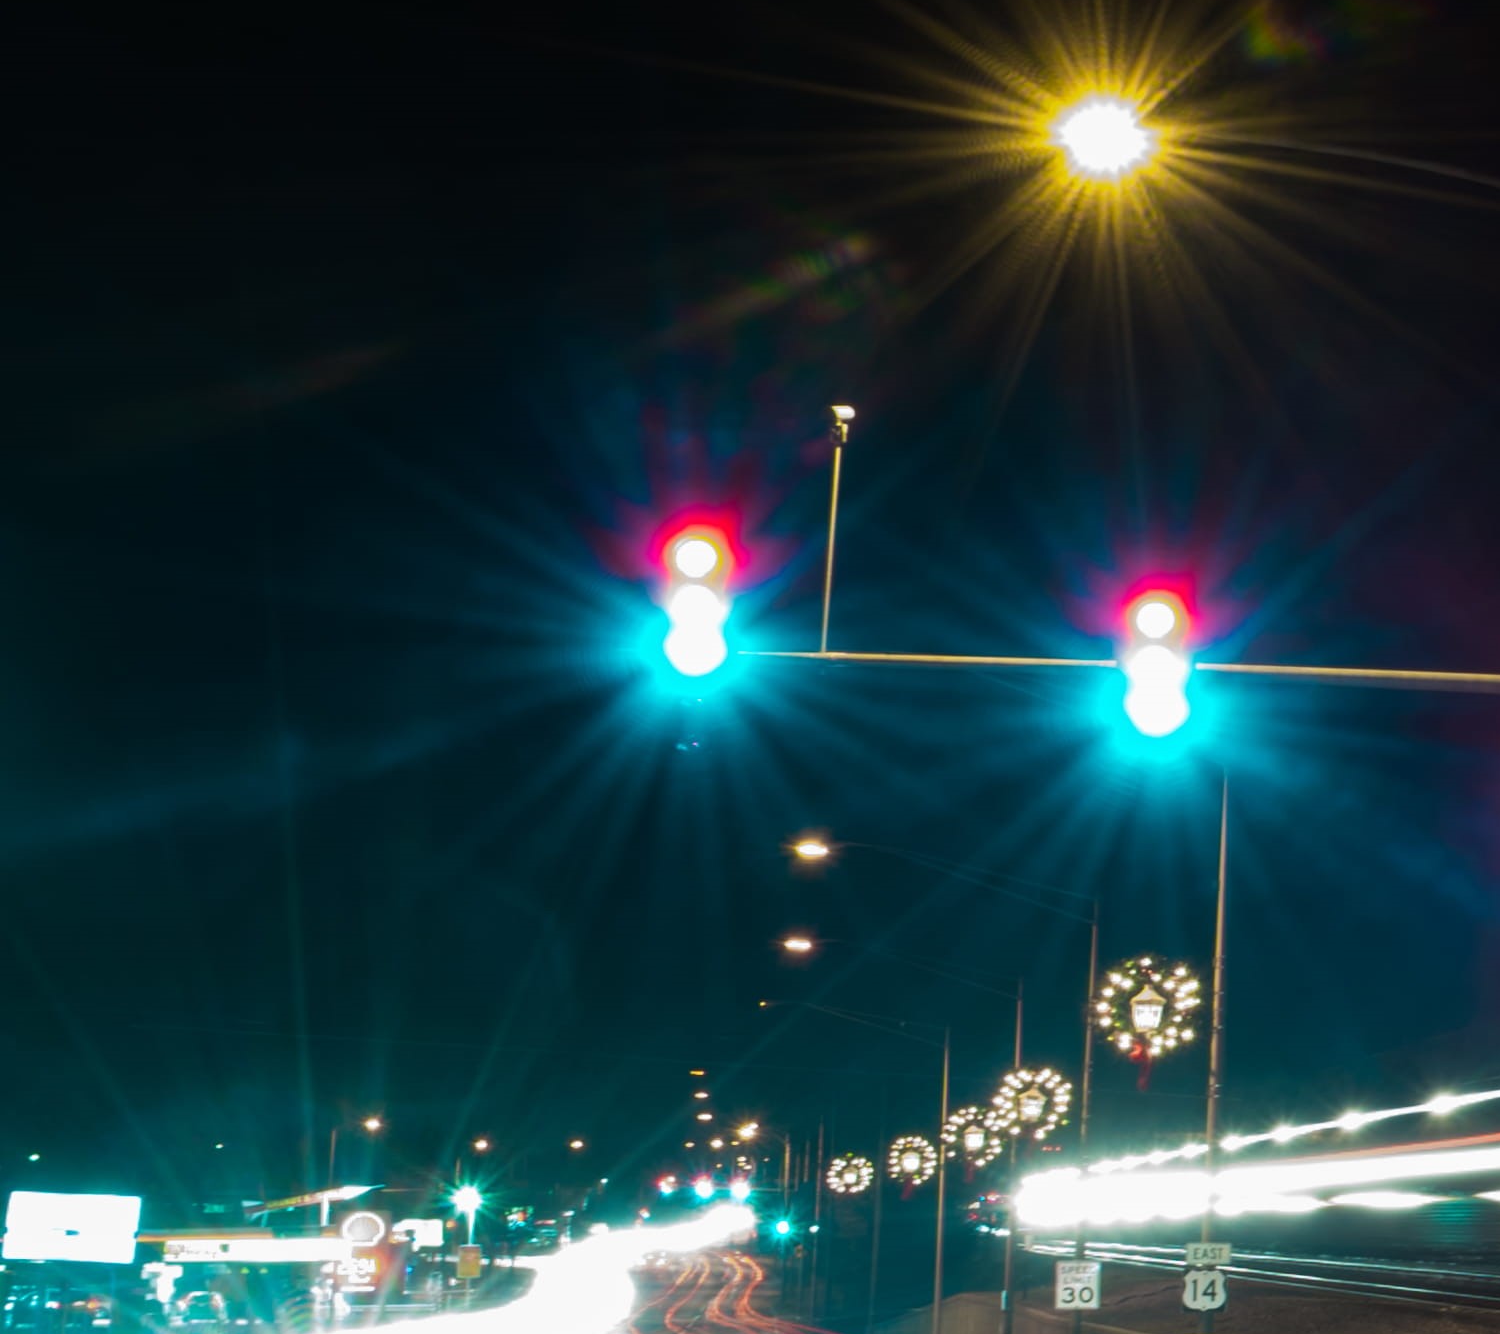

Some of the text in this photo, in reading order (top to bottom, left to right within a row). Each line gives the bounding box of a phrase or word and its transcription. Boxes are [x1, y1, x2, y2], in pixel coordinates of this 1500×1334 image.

[1192, 1247, 1224, 1260] EAST
[1061, 1286, 1094, 1304] 30
[1191, 1279, 1218, 1302] 14
